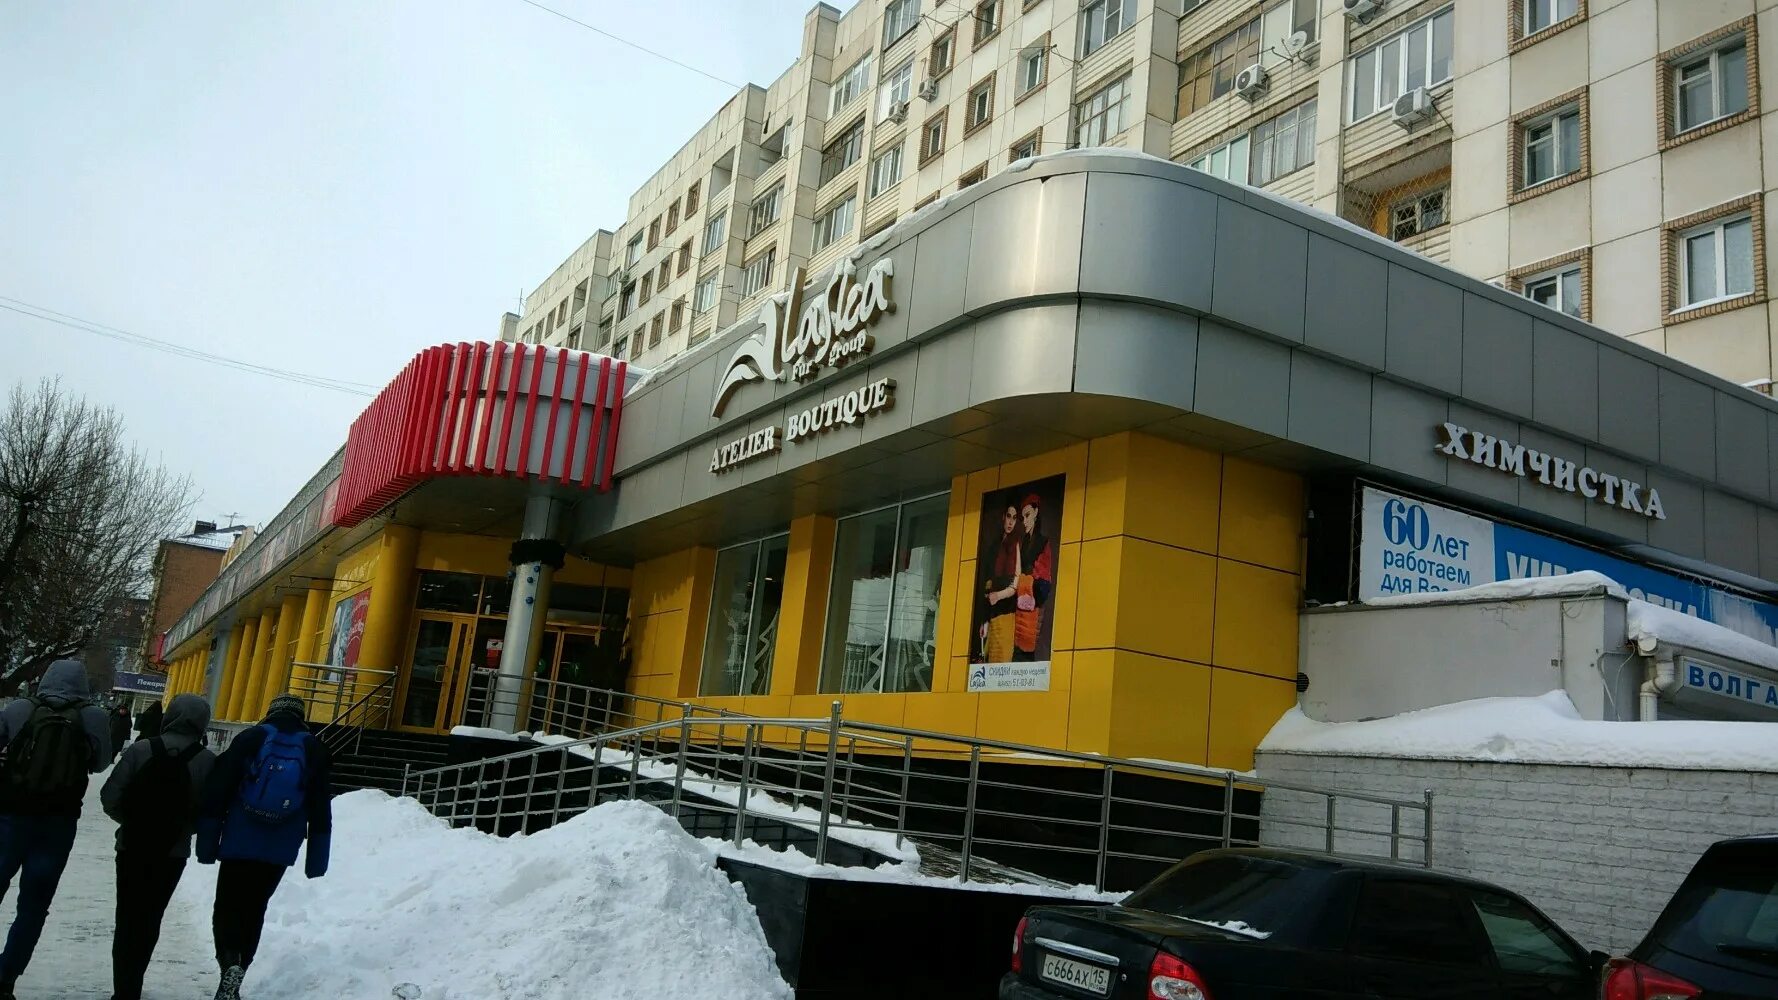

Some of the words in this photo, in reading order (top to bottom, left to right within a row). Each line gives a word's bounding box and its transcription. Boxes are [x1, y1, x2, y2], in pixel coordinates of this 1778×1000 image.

[828, 331, 868, 367] group
[708, 425, 776, 473] ATELIER
[786, 377, 889, 442] BOUTIQUE
[1442, 422, 1667, 520] ХИМЧИСТКА
[1383, 498, 1430, 551] 60
[1432, 533, 1470, 561] лет
[1380, 573, 1412, 594] для
[1383, 549, 1471, 586] работаем
[1689, 665, 1778, 706] ВОЛГА
[1093, 969, 1105, 985] 15
